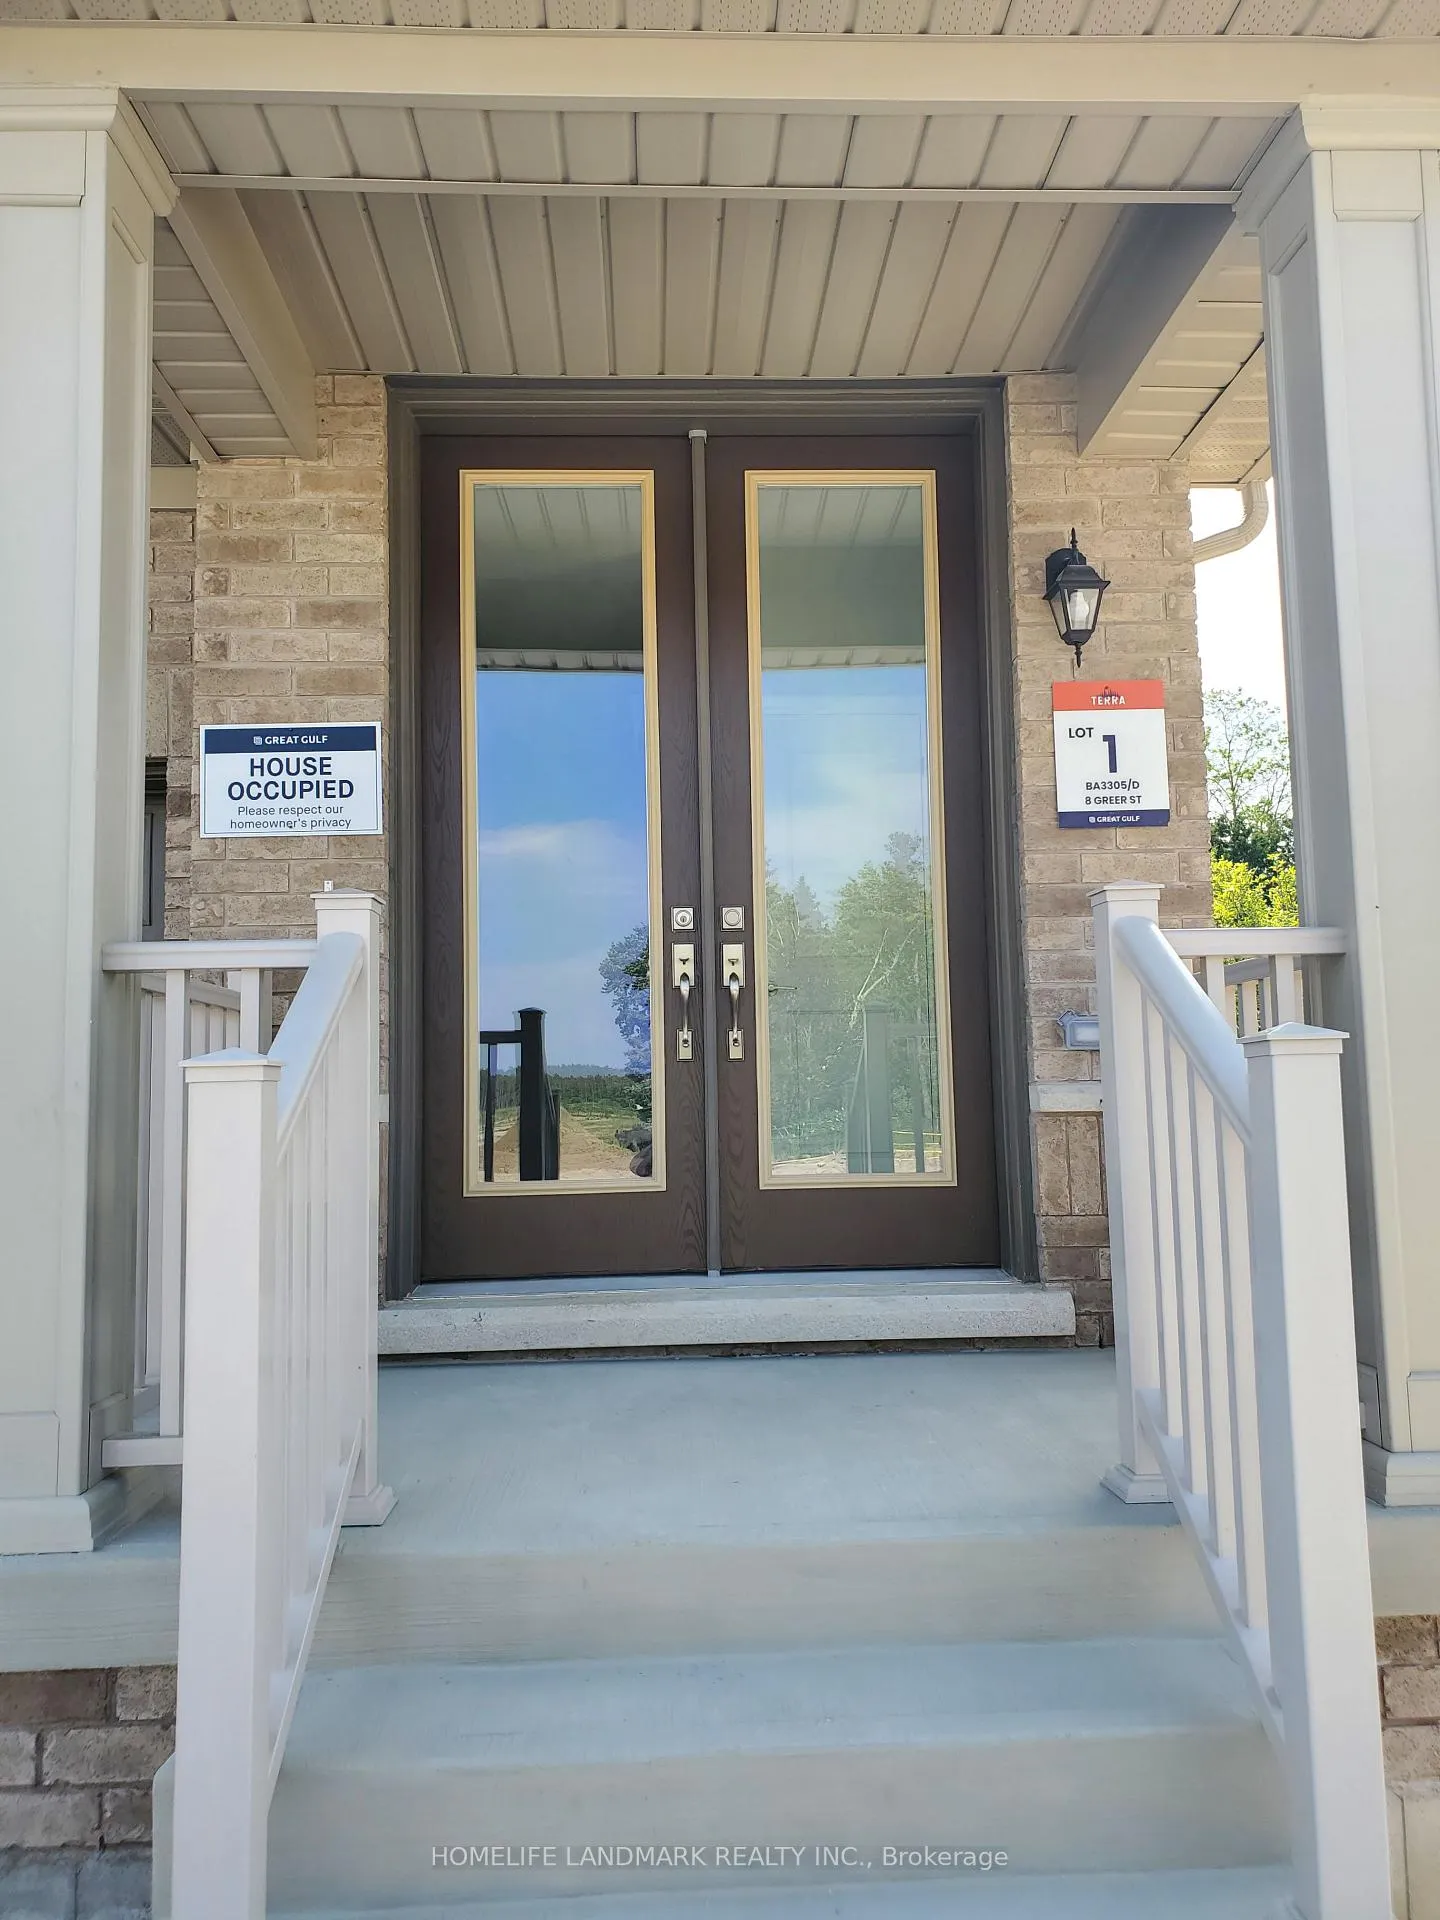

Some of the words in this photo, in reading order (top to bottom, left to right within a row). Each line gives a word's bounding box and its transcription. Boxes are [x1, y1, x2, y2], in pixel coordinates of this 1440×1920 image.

[1091, 695, 1126, 706] TERRA
[1068, 727, 1094, 738] LOT
[264, 736, 299, 745] GREAT
[301, 735, 328, 744] GULF
[1102, 734, 1117, 773] 1
[250, 756, 332, 777] HOUSE
[227, 779, 354, 801] OCCUPIED
[1085, 778, 1140, 792] BA3305/D
[1085, 796, 1092, 805] 8
[1094, 795, 1128, 805] GREER
[1129, 795, 1142, 804] ST
[238, 806, 275, 816] Please
[278, 805, 322, 817] respect
[325, 805, 344, 814] our
[230, 818, 307, 829] homeowner's
[310, 817, 352, 830] privacy
[1096, 815, 1121, 823] GREAT
[1121, 815, 1140, 823] GULF
